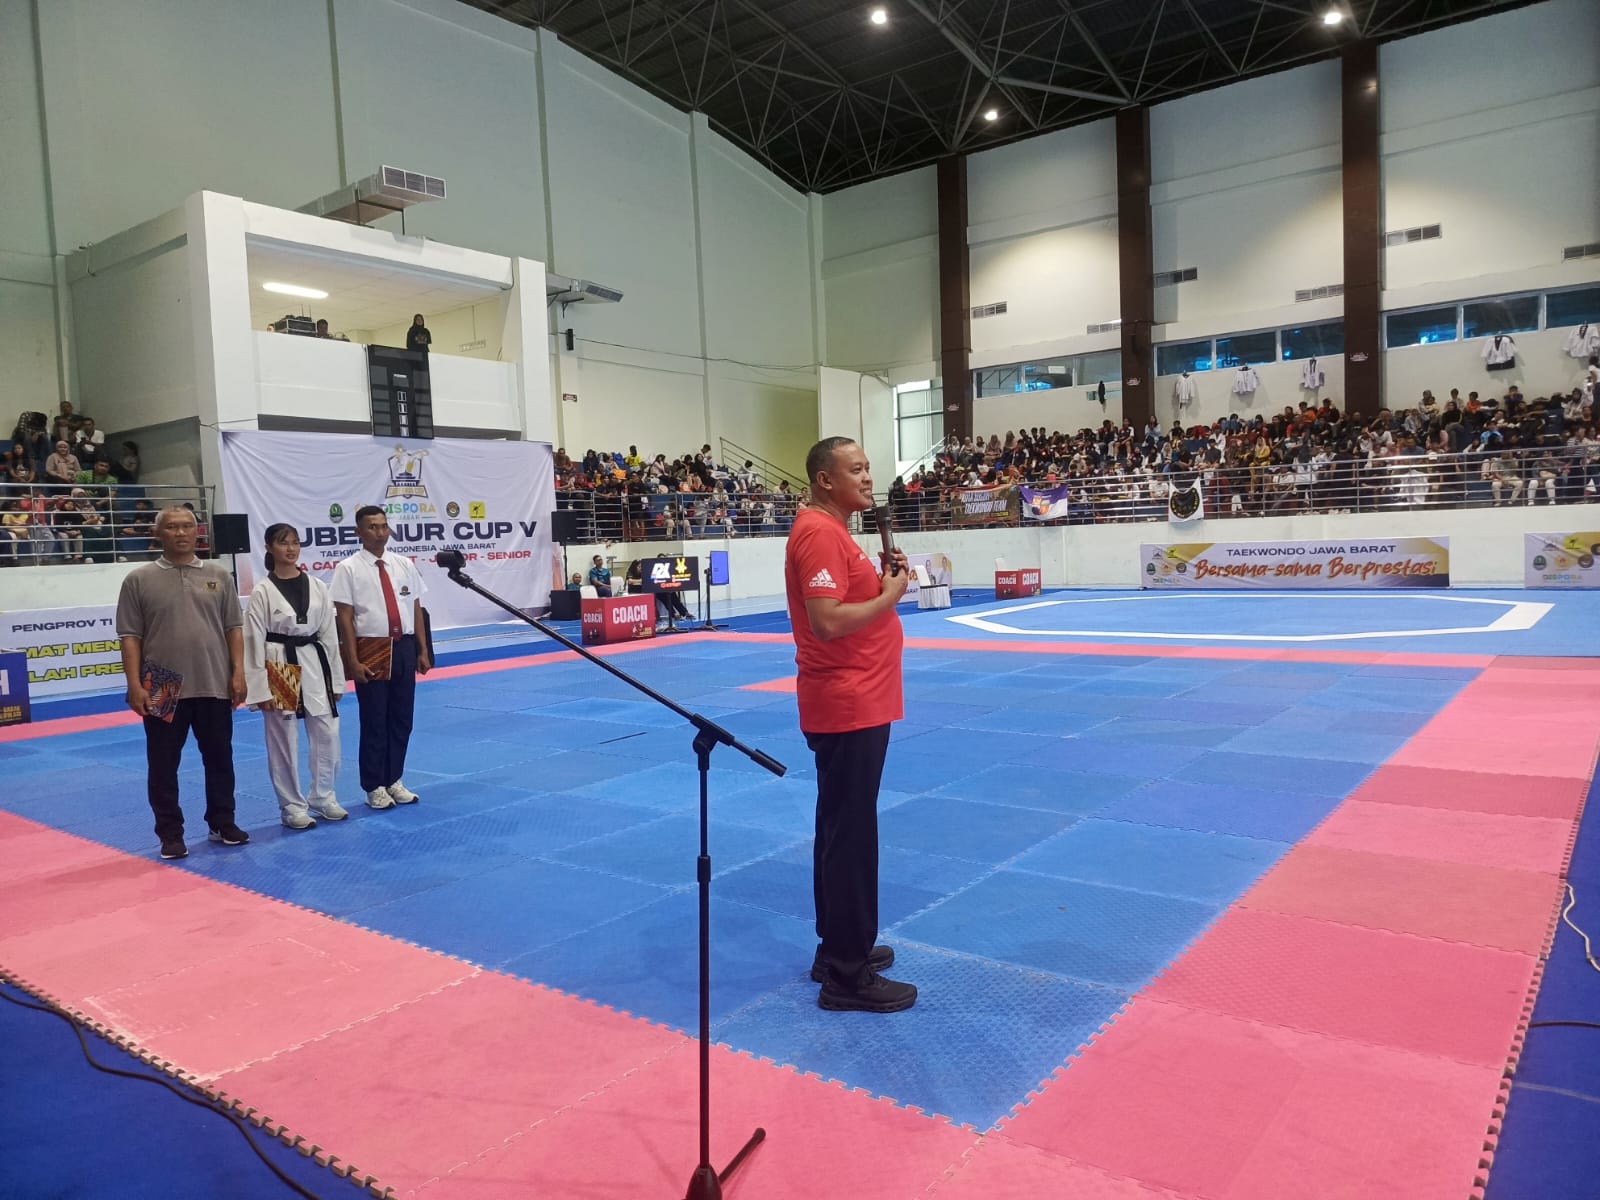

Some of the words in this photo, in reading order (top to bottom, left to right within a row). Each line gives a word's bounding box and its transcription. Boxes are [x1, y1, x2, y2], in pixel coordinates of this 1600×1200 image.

[300, 523, 445, 548] UBENUR
[453, 521, 513, 540] CUP
[519, 521, 537, 538] V
[386, 545, 437, 553] INDONESIA
[487, 551, 531, 560] SENIOR
[1227, 547, 1305, 557] TAEKWONDO
[1309, 546, 1346, 555] JAWA
[1350, 545, 1397, 554] BARAT
[1327, 556, 1438, 581] Berprestasi
[809, 580, 837, 589] adidas
[998, 577, 1016, 585] COACH
[583, 612, 603, 624] COACH
[612, 604, 648, 625] COACH
[12, 619, 96, 633] PENGPROV
[100, 618, 113, 626] TI
[72, 639, 122, 654] MEN
[28, 665, 77, 683] LAH
[80, 661, 125, 678] PRE
